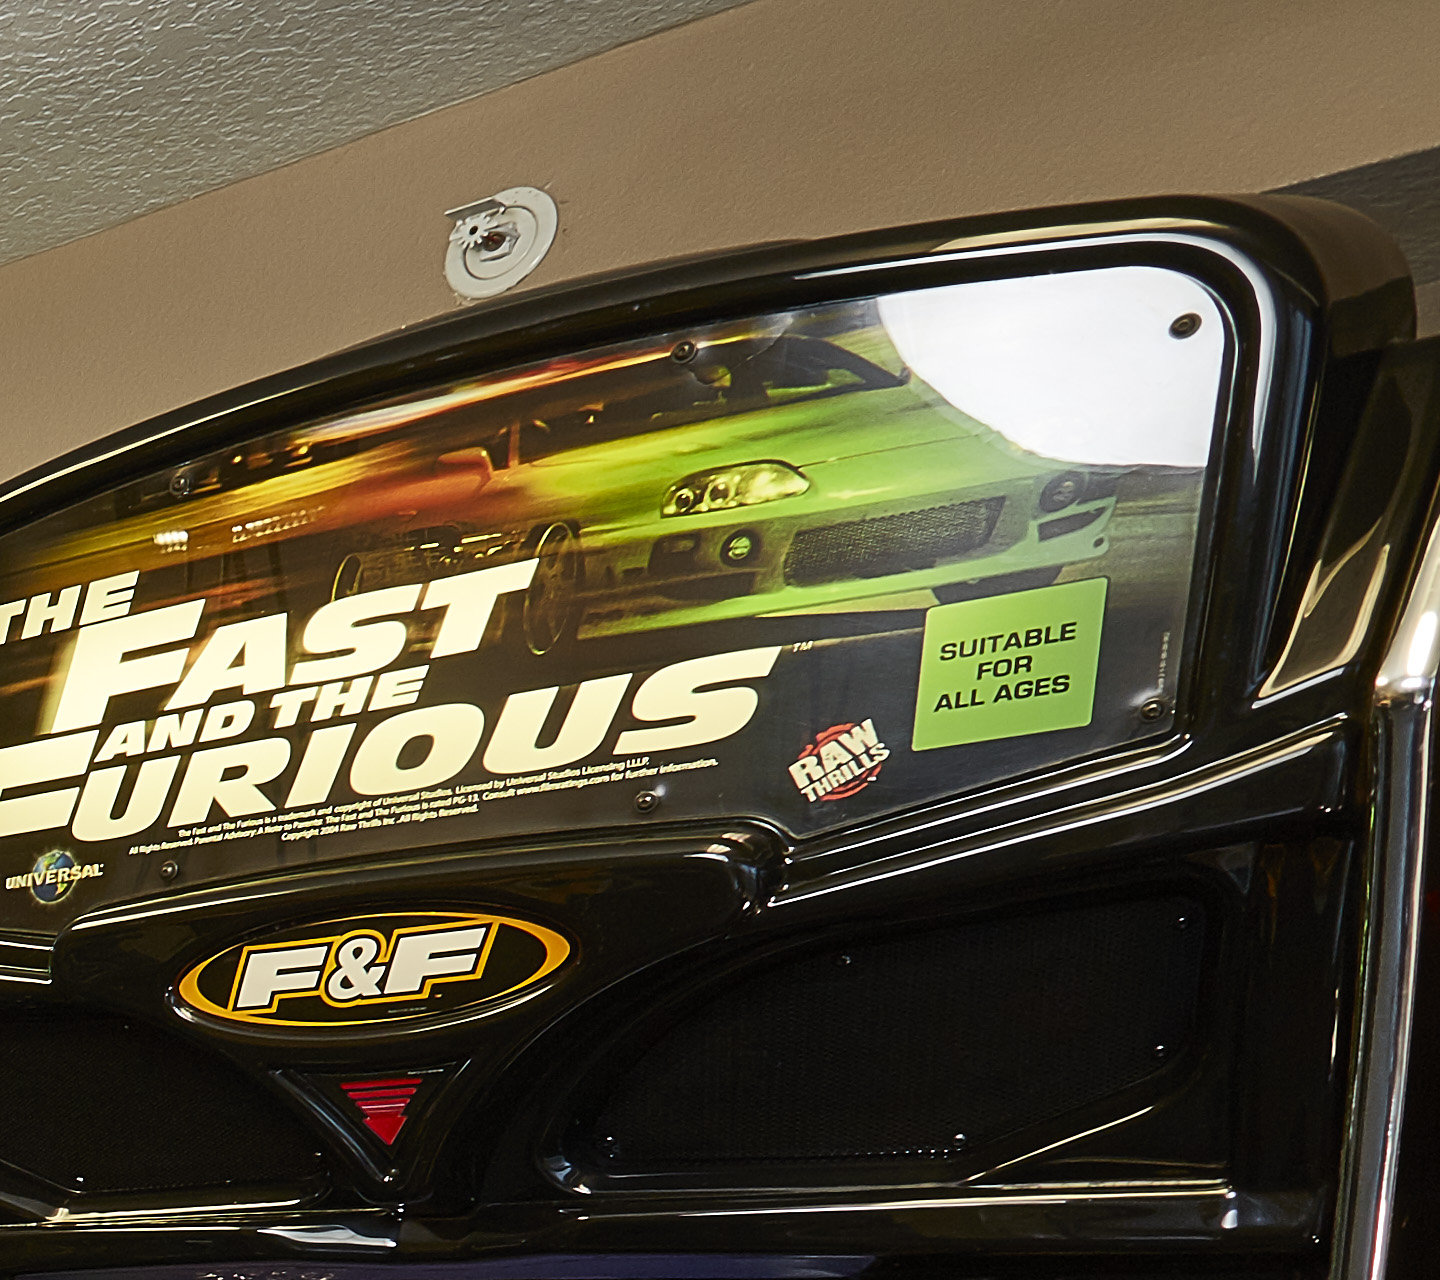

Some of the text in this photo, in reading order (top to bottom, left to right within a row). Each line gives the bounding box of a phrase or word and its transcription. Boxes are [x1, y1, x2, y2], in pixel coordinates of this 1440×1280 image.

[50, 559, 539, 735] FAST
[939, 621, 1078, 661] SUITABLE
[977, 655, 1032, 681] FOR
[93, 663, 429, 763] AND THE
[934, 674, 1070, 713] ALL AGES
[788, 718, 879, 787] RAW
[800, 741, 890, 802] THRILLS
[5, 862, 103, 892] UNIVERSAL
[236, 927, 486, 1009] F&F
